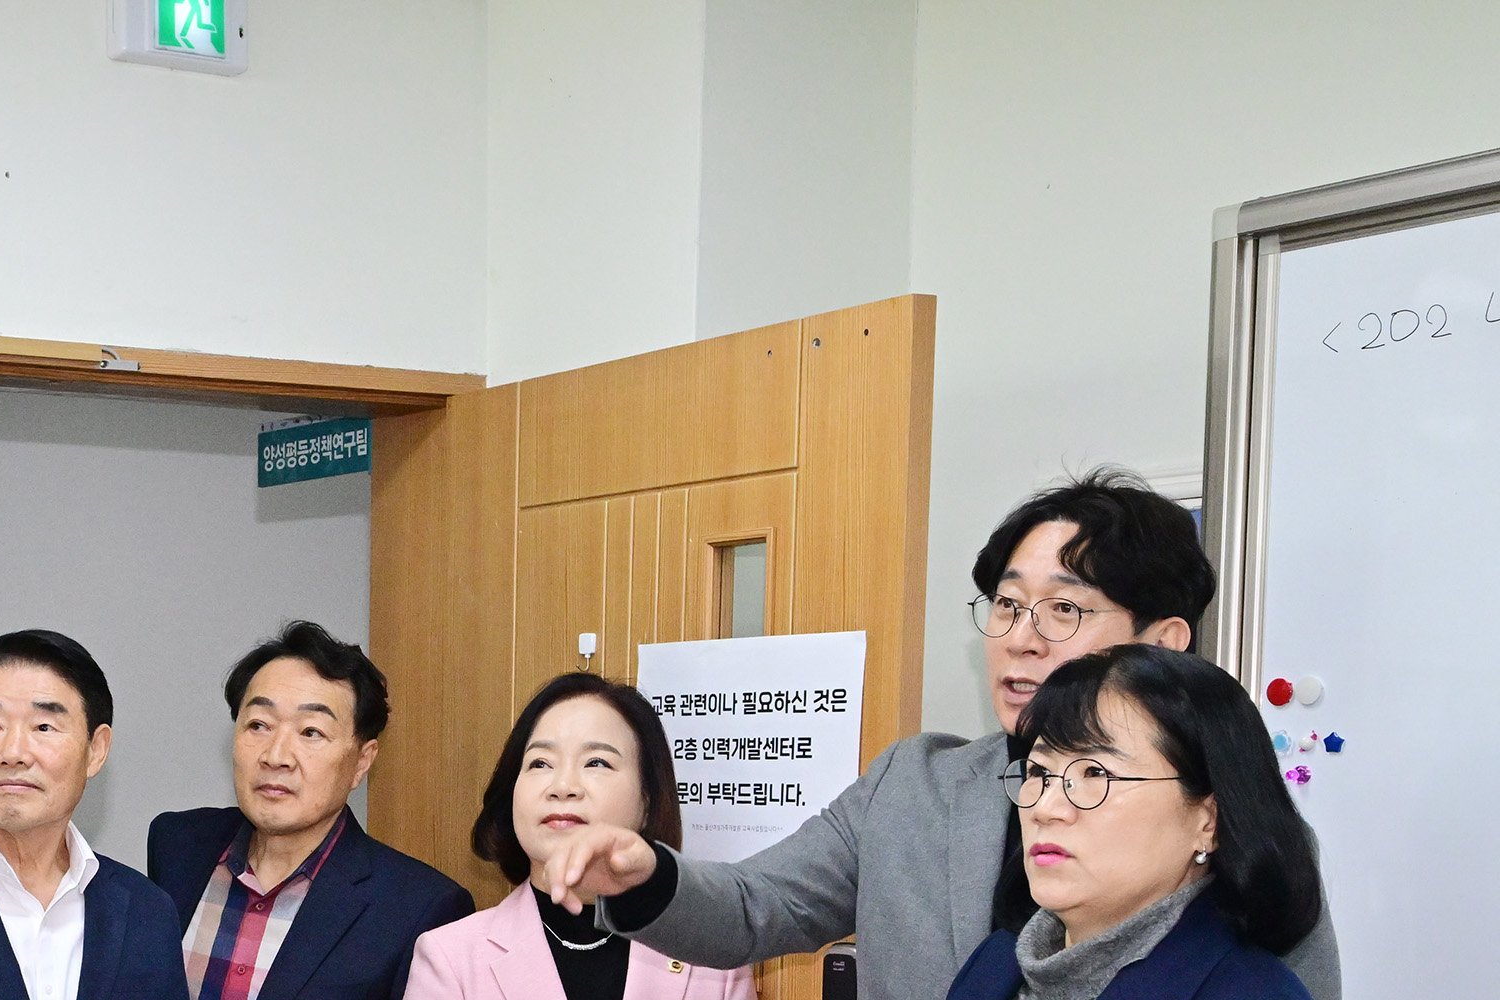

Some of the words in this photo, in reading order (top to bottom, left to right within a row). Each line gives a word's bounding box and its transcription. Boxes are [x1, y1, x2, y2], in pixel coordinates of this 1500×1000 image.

[263, 428, 368, 472] 양성평등정책연구팀
[651, 695, 676, 717] 교육
[679, 692, 738, 717] 관련이나
[742, 690, 807, 715] 필요하신
[813, 688, 847, 714] 것은
[674, 737, 698, 761] 2층
[702, 736, 813, 761] 인력개발센터로
[677, 782, 703, 805] 문의
[707, 782, 806, 806] 부탁드립니다.
